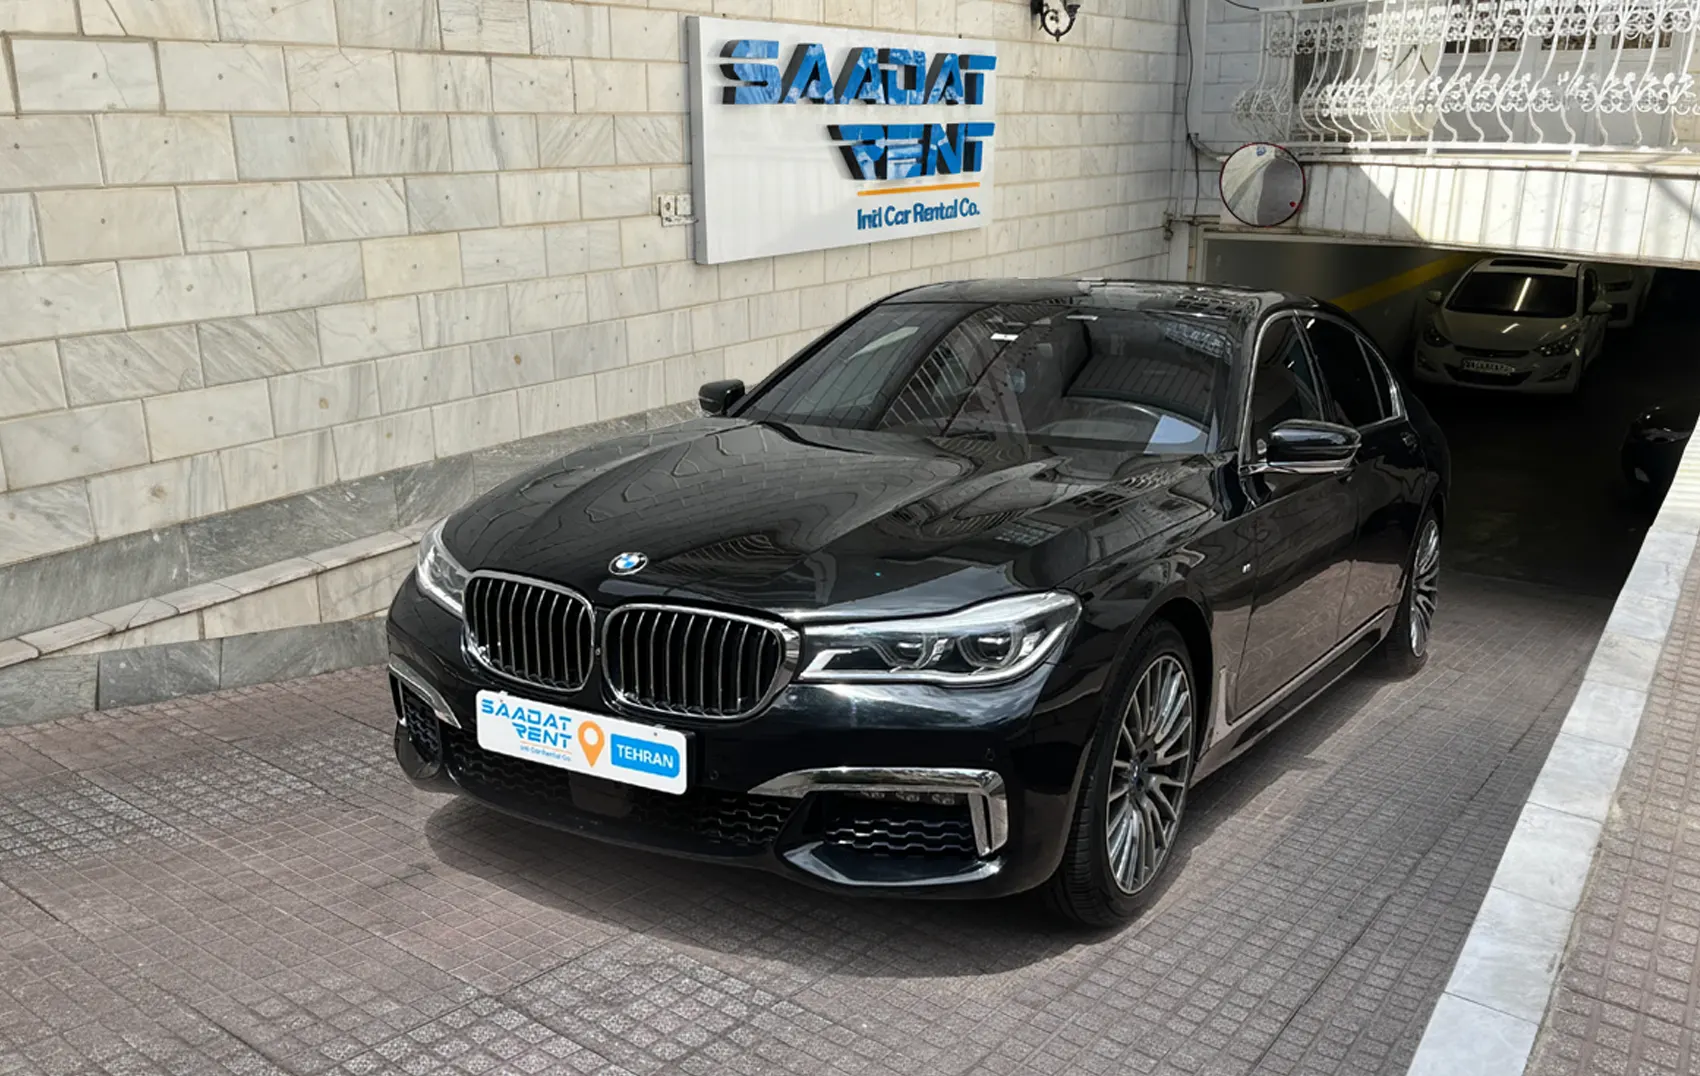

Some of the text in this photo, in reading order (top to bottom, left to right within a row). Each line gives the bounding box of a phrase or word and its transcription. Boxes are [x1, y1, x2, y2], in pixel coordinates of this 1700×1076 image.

[720, 39, 996, 105] SAADAT
[827, 122, 995, 180] RENT
[884, 205, 911, 226] Car
[913, 199, 958, 222] Rental
[960, 198, 980, 217] Co.
[481, 699, 572, 731] SAADAT
[512, 722, 572, 748] RENT
[616, 744, 674, 769] TEHRAN
